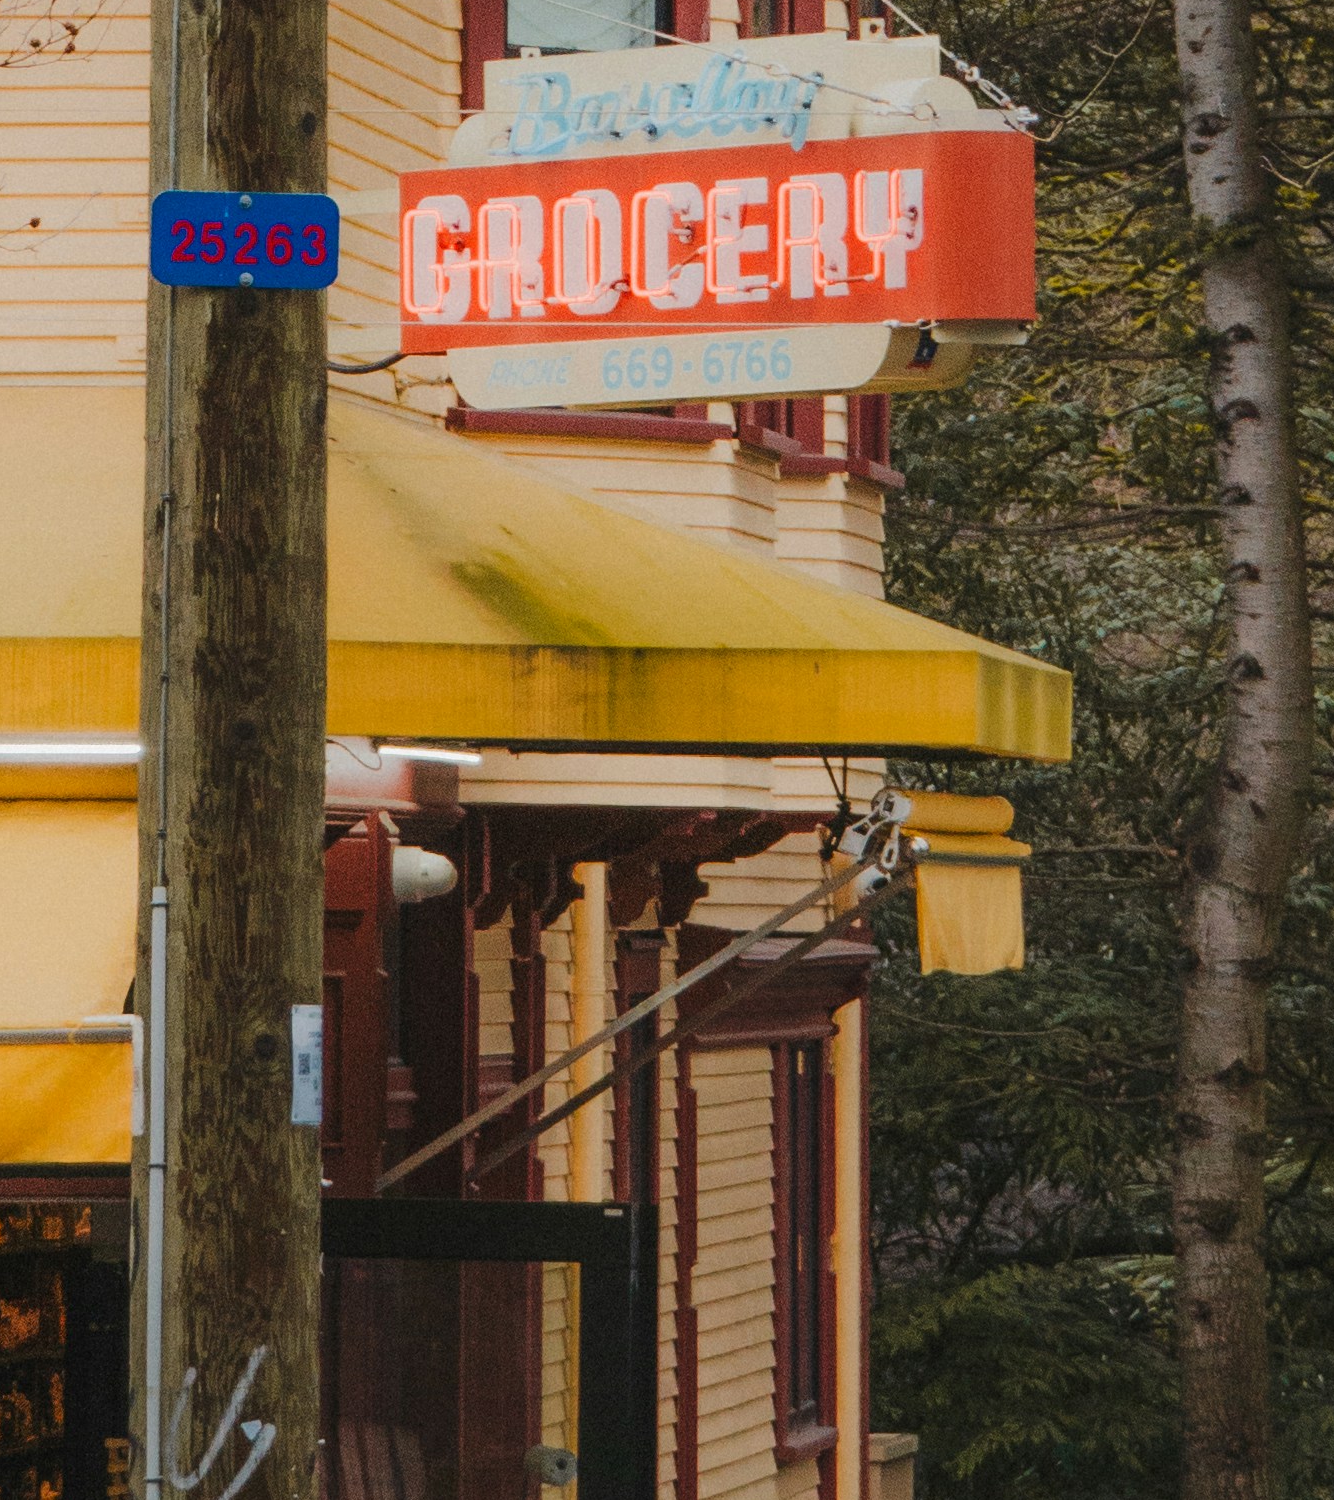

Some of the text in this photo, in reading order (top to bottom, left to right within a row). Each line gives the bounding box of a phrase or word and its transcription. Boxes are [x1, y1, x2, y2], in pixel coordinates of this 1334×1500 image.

[170, 219, 328, 267] 25263
[403, 168, 924, 324] GROCERY
[487, 355, 572, 388] PHONE
